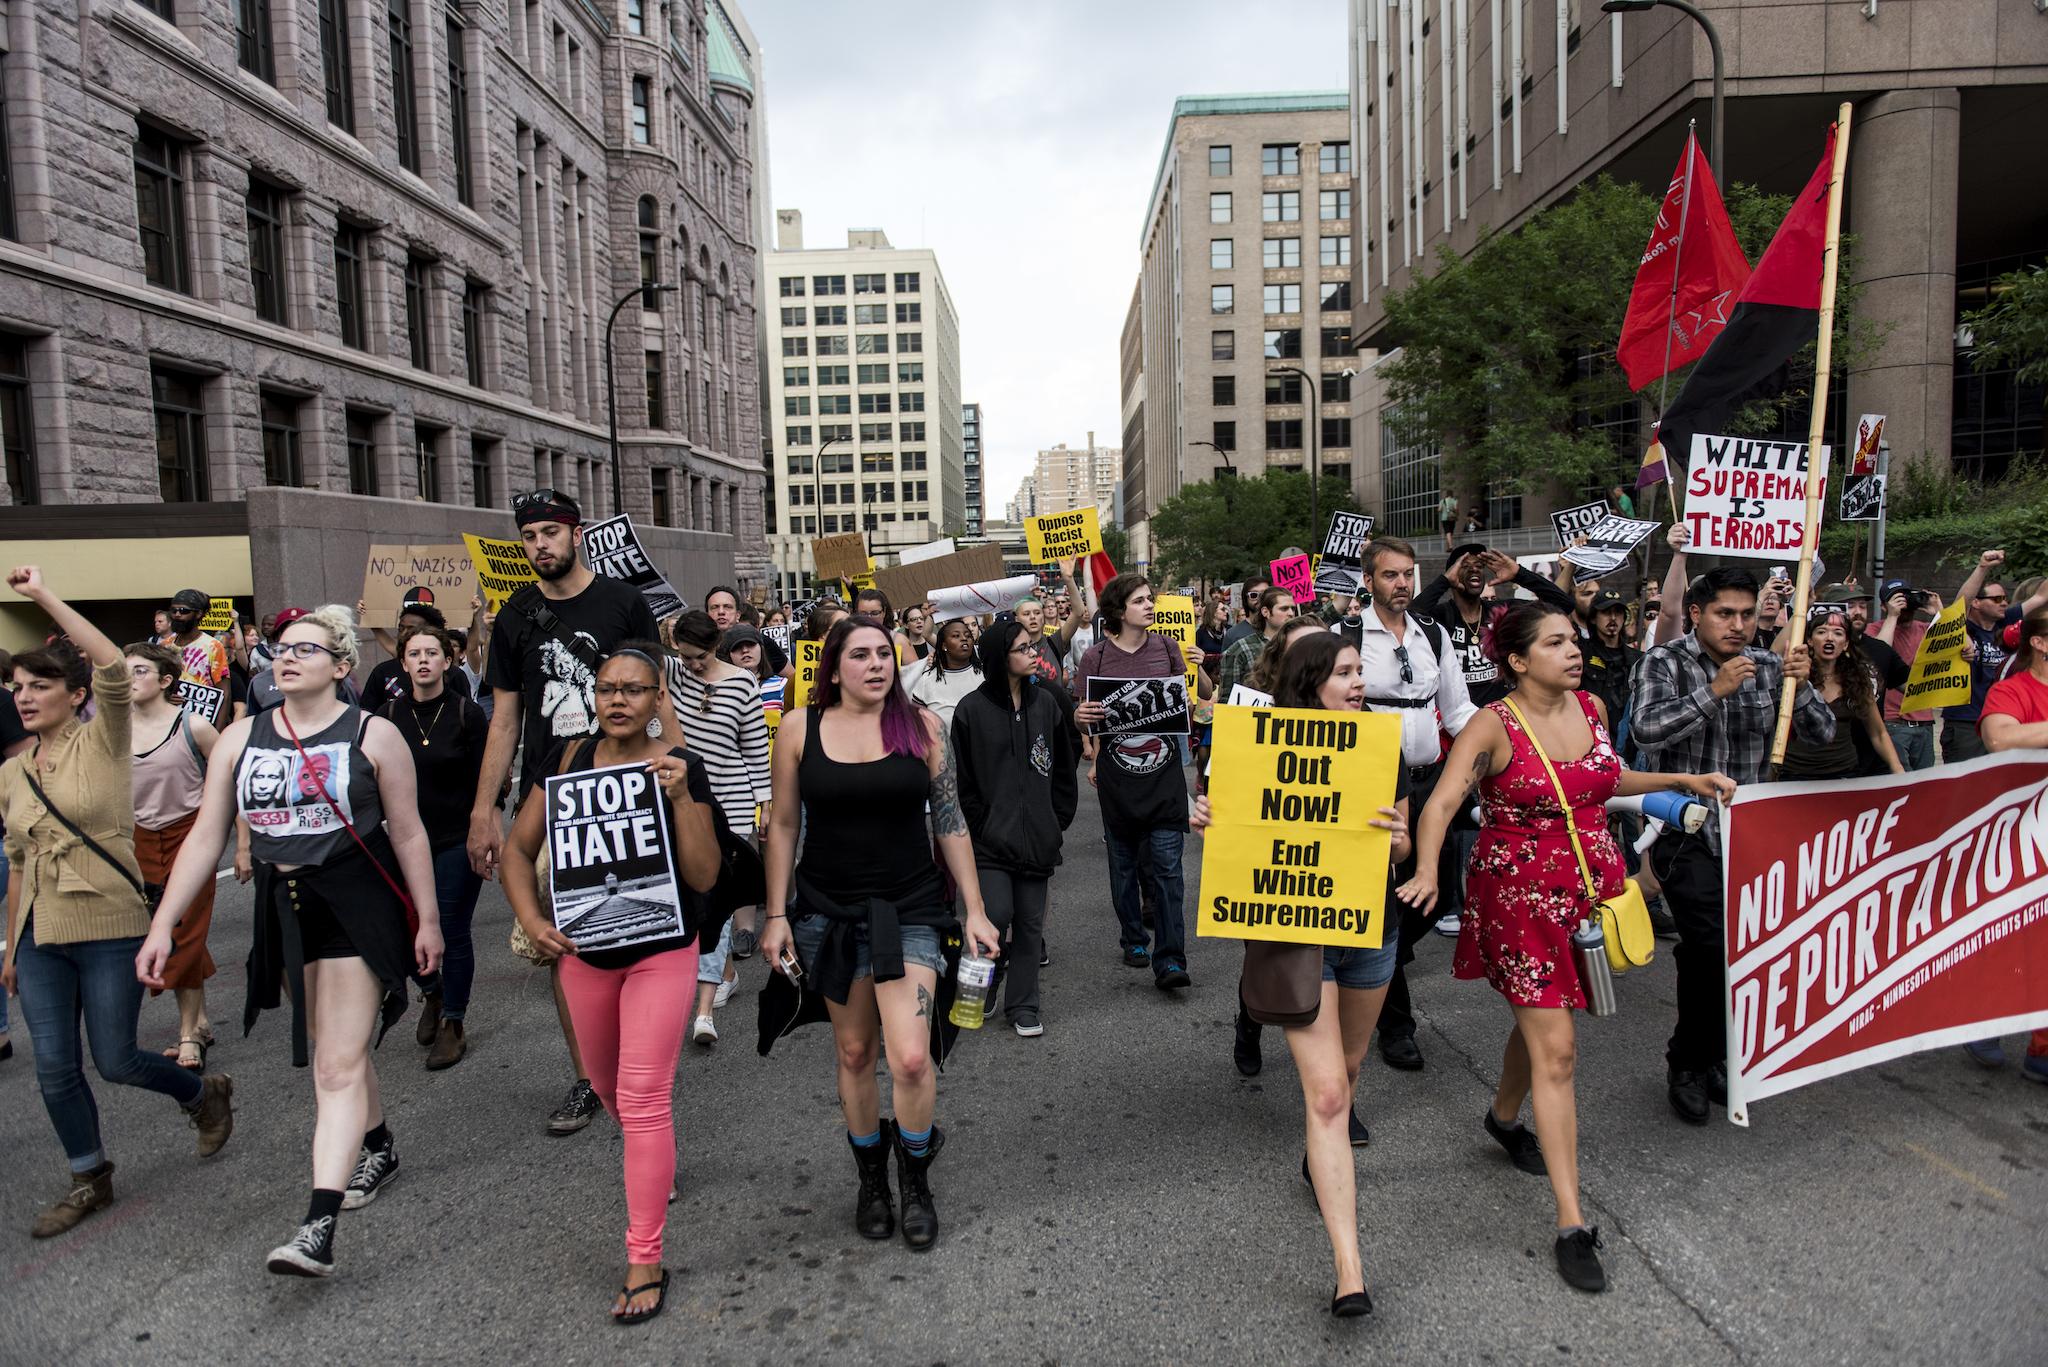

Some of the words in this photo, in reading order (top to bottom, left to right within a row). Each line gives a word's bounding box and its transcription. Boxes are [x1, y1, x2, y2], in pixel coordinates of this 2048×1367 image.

[1706, 437, 1809, 472] WHITE
[1559, 505, 1603, 532] STOP
[1729, 498, 1765, 518] IS
[1038, 513, 1084, 532] Oppose
[1334, 515, 1370, 537] STOP
[1603, 518, 1653, 531] STOP
[1686, 511, 1819, 550] TERRORIS
[588, 522, 627, 558] STOP
[1043, 527, 1083, 545] Racist
[1590, 528, 1644, 543] HATE
[478, 539, 530, 560] Smash
[1041, 539, 1091, 560] Attacks!
[370, 557, 395, 577] NO
[487, 557, 532, 577] White
[590, 548, 650, 580] HATE
[1277, 561, 1304, 583] NOT
[393, 574, 417, 587] OUR
[427, 575, 463, 587] LAND
[479, 572, 540, 593] Suprem
[1288, 582, 1310, 599] AY!
[212, 600, 230, 609] with
[1926, 631, 1965, 653] Against
[1923, 660, 1952, 678] White
[177, 683, 218, 704] STOP
[1099, 689, 1122, 709] ACIST
[1120, 680, 1138, 695] USA
[1906, 674, 1969, 697] Supremacy
[182, 700, 215, 720] ATE
[1253, 712, 1357, 751] Trump
[1125, 763, 1158, 772] ACTION
[1276, 751, 1332, 785] Out
[557, 772, 646, 820] STOP
[1261, 788, 1341, 823] Now!
[296, 806, 334, 817] PUSS
[555, 819, 573, 828] STAND
[572, 816, 596, 826] AGAINST
[597, 813, 617, 822] WHITE
[616, 808, 653, 820] SUPREMACY
[555, 815, 661, 870] HATE
[1271, 839, 1321, 867] End
[1253, 869, 1334, 898] White
[1737, 859, 1785, 952] NO
[1797, 794, 1910, 911] MORE
[1213, 896, 1370, 935] Supremacy
[1733, 784, 2048, 1077] DEPORTATION
[1848, 1003, 1876, 1038] MIRAC
[1882, 965, 1930, 1012] MINNESOTA
[1931, 931, 1983, 978] IMMIGRANT
[1984, 912, 2021, 946] RIGHTS
